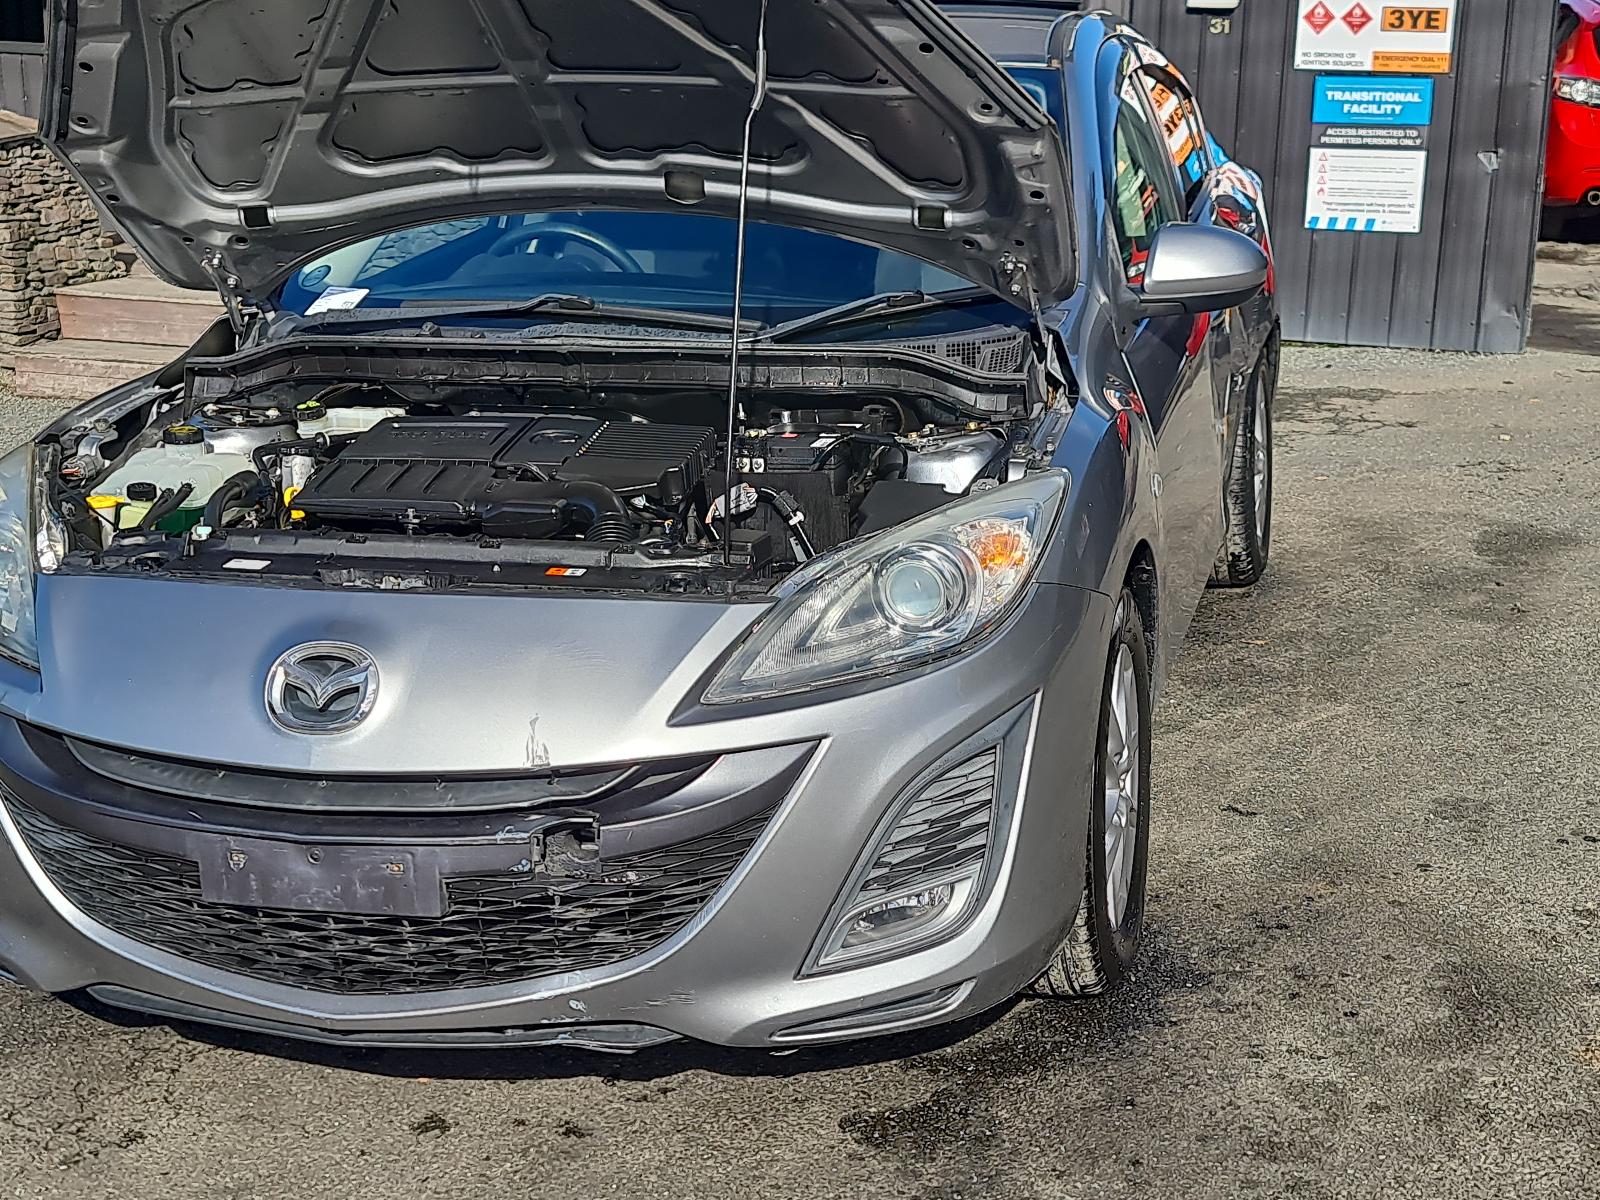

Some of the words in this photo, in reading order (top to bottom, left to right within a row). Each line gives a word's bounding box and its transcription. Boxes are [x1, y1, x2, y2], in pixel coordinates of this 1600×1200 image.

[1389, 10, 1440, 29] 3YE
[1209, 18, 1231, 34] 31
[1326, 91, 1422, 102] TRANSITIONAL
[1343, 104, 1403, 114] FACILITY
[1326, 128, 1357, 136] ACCESS
[1358, 128, 1405, 137] RESTRICTED
[1406, 129, 1419, 138] TO
[1320, 135, 1362, 145] PERMITTED
[1363, 137, 1399, 146] PERSONS
[1399, 138, 1423, 146] ONLY
